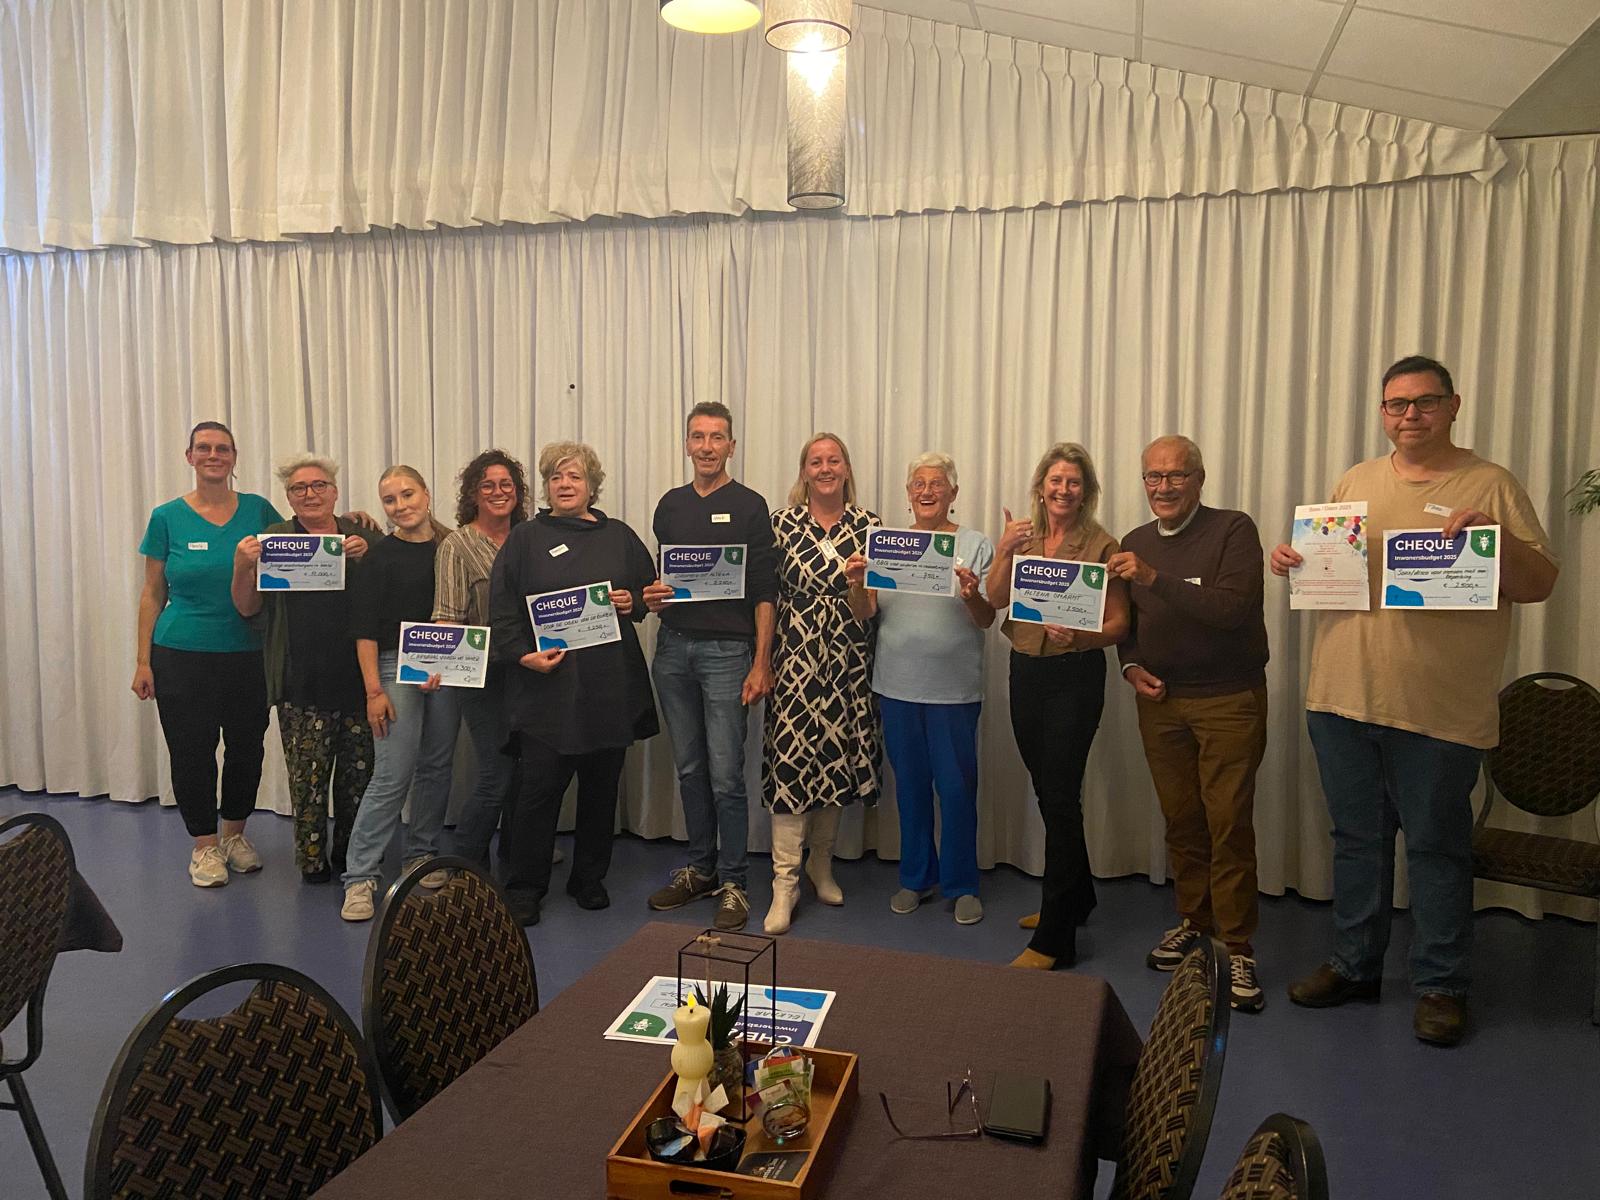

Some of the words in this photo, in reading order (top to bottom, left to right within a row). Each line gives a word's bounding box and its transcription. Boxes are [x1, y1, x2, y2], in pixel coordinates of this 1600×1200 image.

[266, 541, 310, 550] CHEQUE
[876, 536, 920, 547] CHEQUE
[1395, 540, 1454, 552] CHEQUE
[670, 552, 712, 562] CHEQUE
[1021, 565, 1068, 578] CHEQUE
[1020, 578, 1058, 586] Inwonersbudget
[1024, 590, 1050, 598] ALTENA
[536, 596, 578, 611] CHEQUE
[538, 609, 572, 618] Inwonersbudget
[409, 631, 454, 641] CHEQUE
